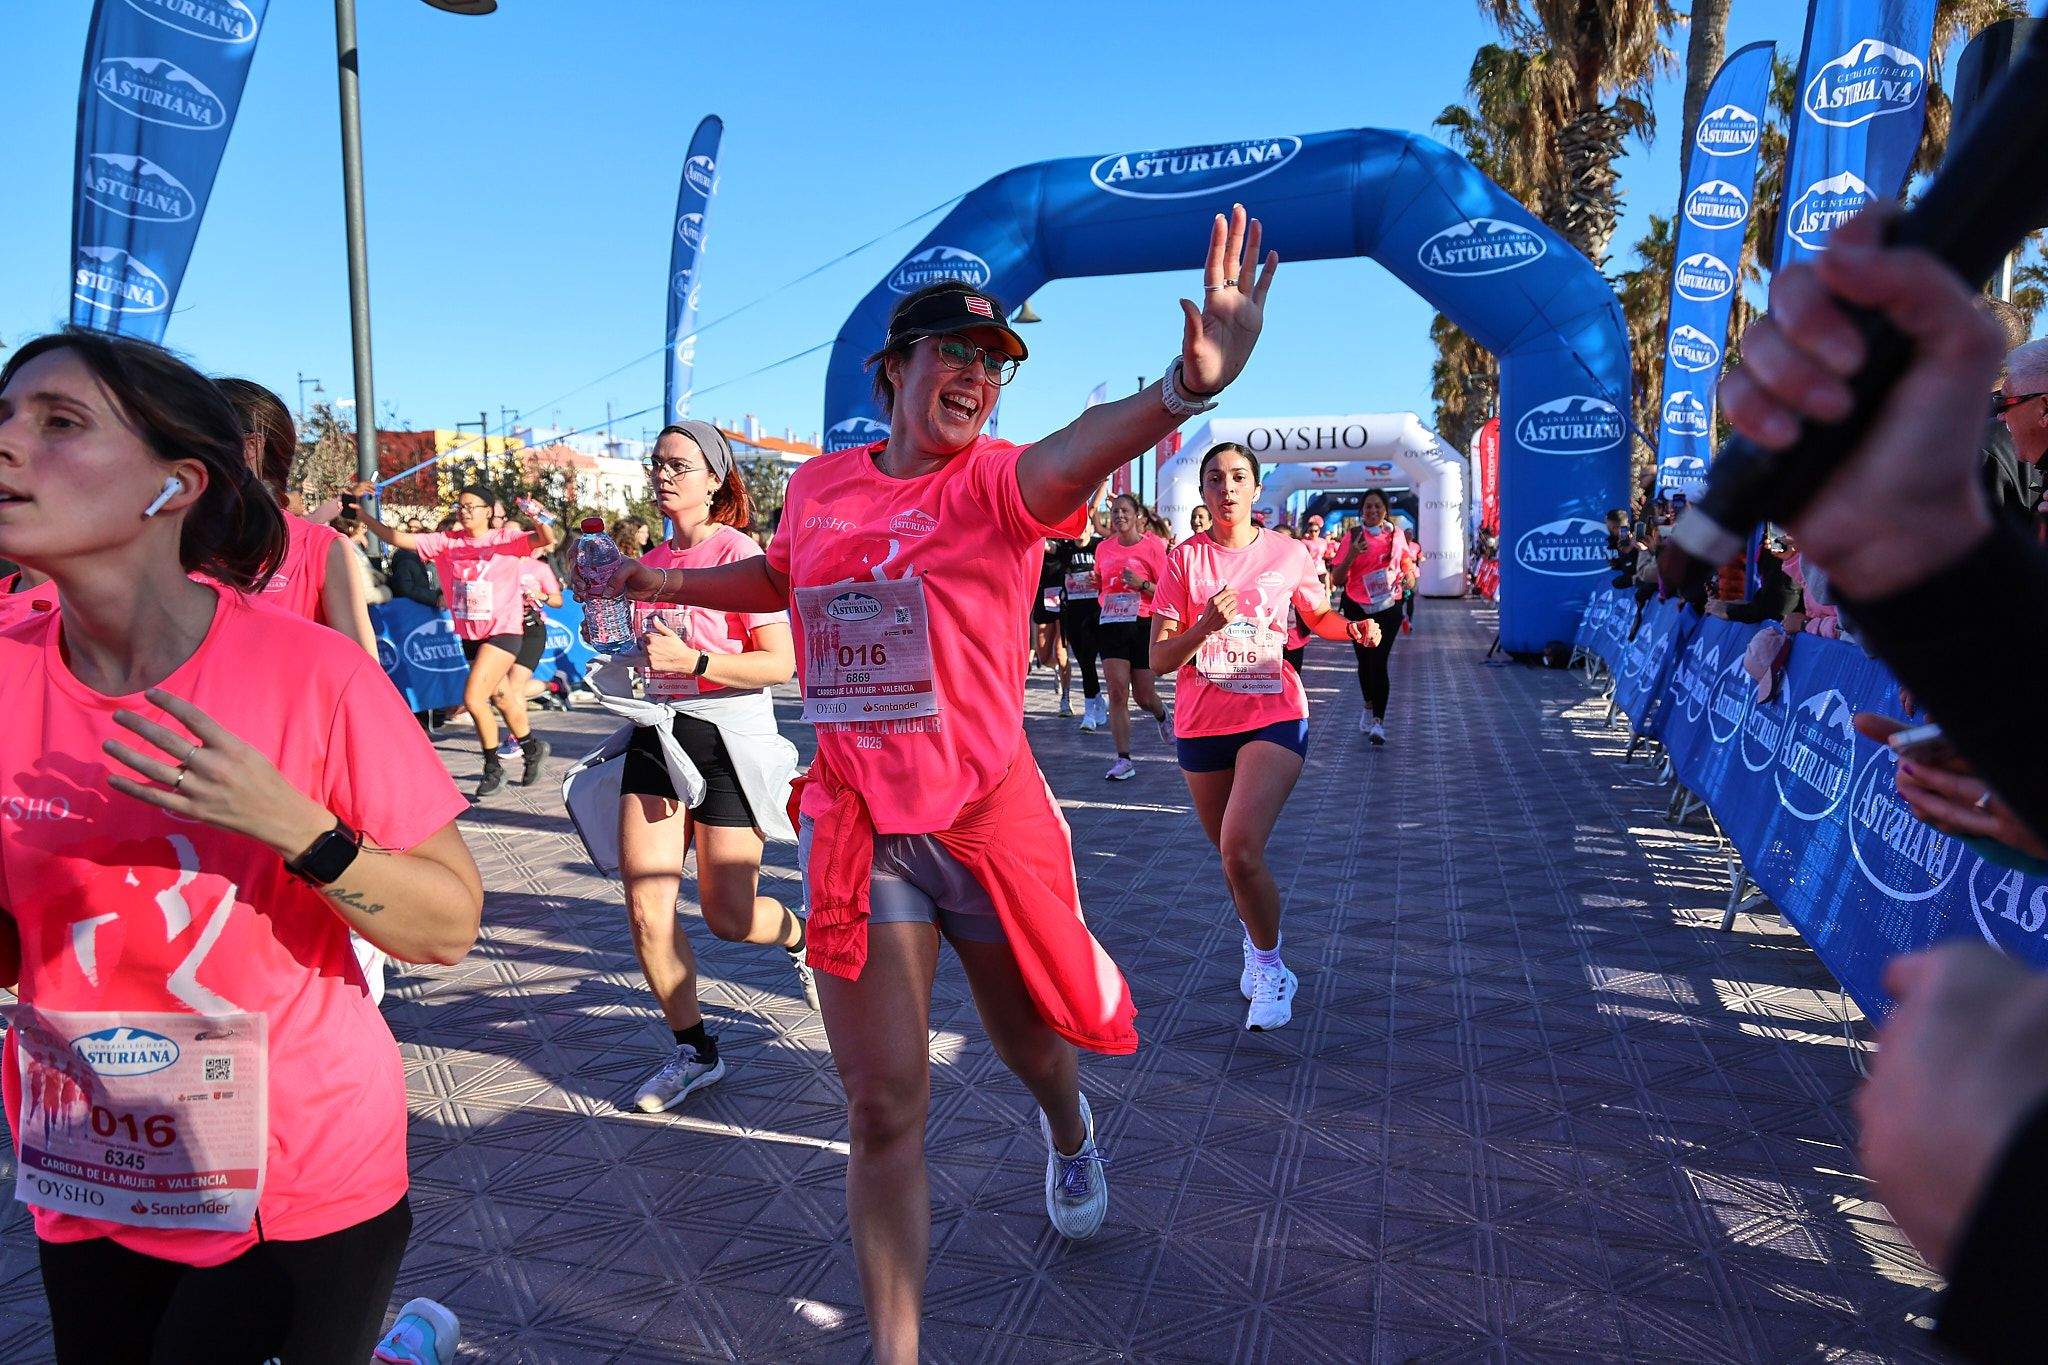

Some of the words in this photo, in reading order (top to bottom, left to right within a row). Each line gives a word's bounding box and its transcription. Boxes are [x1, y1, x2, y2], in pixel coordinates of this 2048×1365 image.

[98, 67, 212, 125] ASTURIANA
[1814, 77, 1911, 111] ASTRIANA
[1105, 143, 1284, 183] ASTURIANA
[1689, 196, 1742, 218] ASTURIANA
[1429, 241, 1538, 266] ASTURIANA
[893, 268, 981, 286] ASTURIANA
[1247, 424, 1369, 451] OYSHO
[1523, 420, 1620, 442] ASTURIANA
[832, 603, 879, 616] ASTURIANA
[413, 636, 465, 662] ASTURI
[838, 644, 886, 667] 016
[1227, 651, 1257, 663] 016
[846, 673, 870, 683] 6869
[855, 686, 877, 694] MUJER
[882, 684, 914, 693] VALENCIA
[817, 702, 846, 715] OYSHO
[874, 701, 919, 712] Santander
[894, 716, 941, 734] MUJER
[857, 736, 882, 750] 2025
[1780, 722, 1844, 801] ASTURIANA
[92, 1105, 177, 1148] 016
[105, 1149, 145, 1170] 6345
[41, 1157, 83, 1176] CARRERA
[87, 1167, 99, 1180] DE
[102, 1170, 116, 1183] LA
[119, 1174, 155, 1188] MUJER
[168, 1174, 228, 1189] VALENCIA
[38, 1179, 105, 1206] OYSHO
[151, 1202, 230, 1216] Santander
